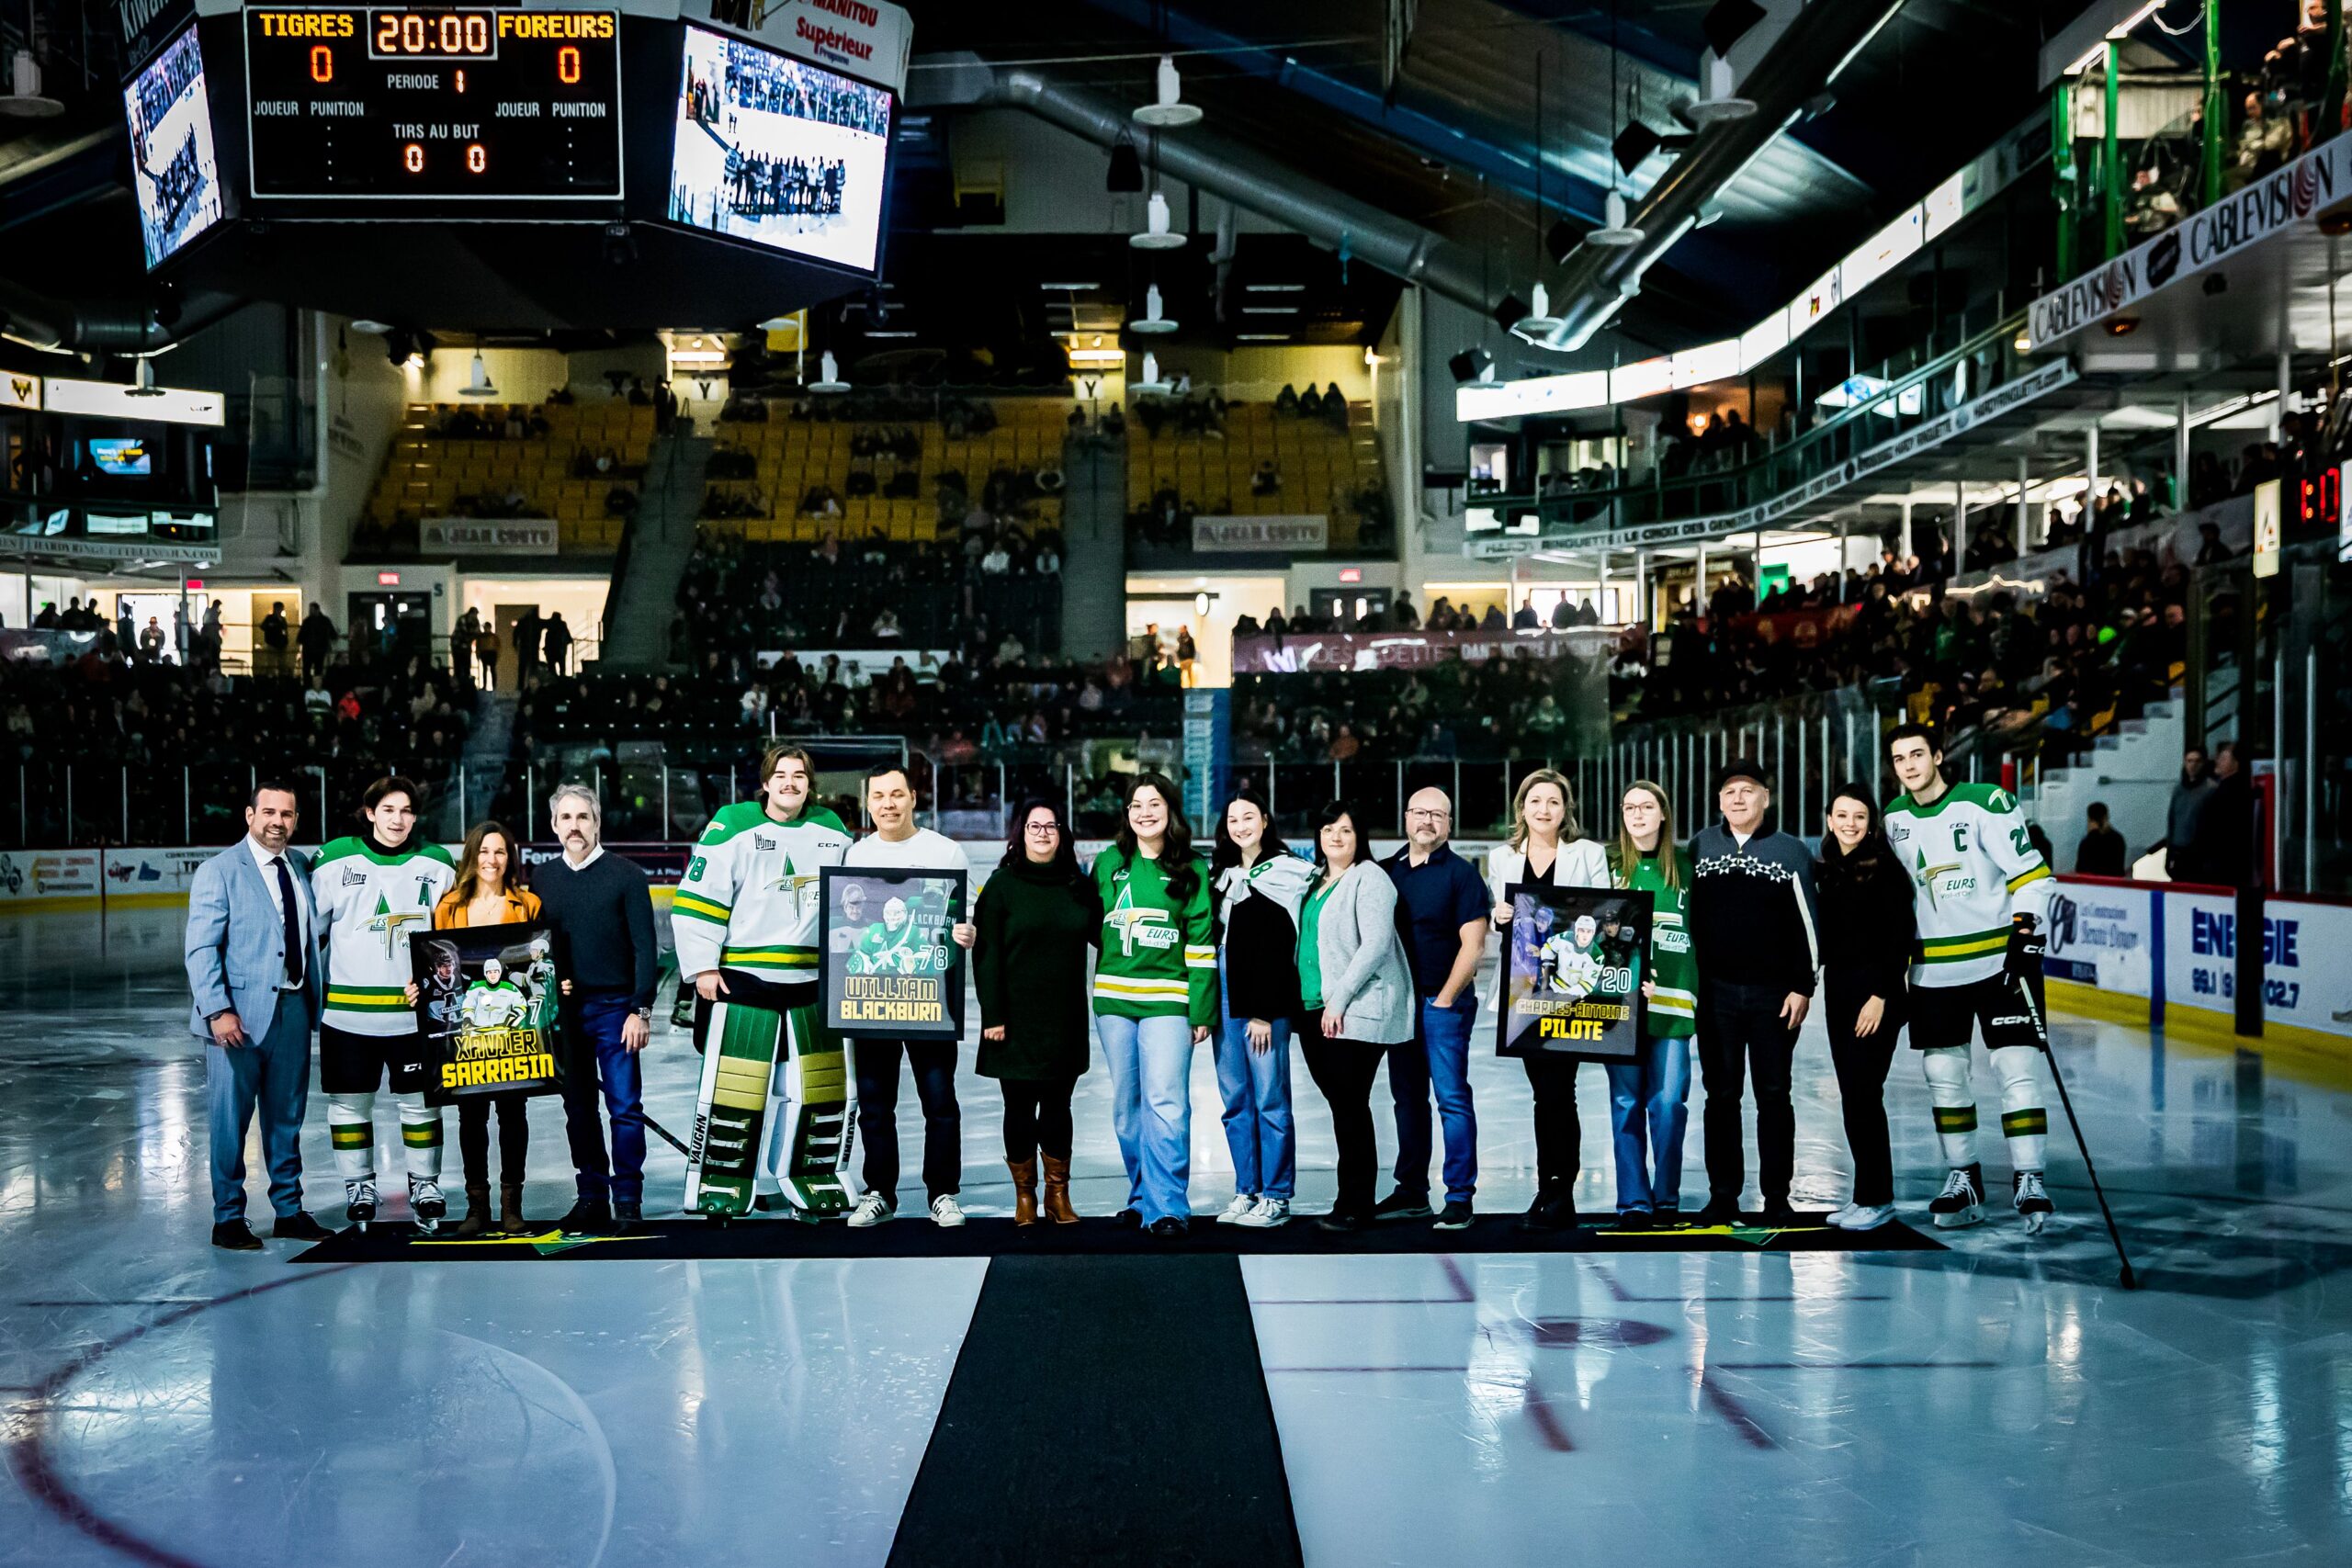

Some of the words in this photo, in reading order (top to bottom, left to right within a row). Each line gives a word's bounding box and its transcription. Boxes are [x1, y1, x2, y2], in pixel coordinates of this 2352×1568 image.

[259, 14, 354, 37] TIGRES
[379, 15, 487, 52] 20:00
[498, 15, 614, 38] FOREURS
[796, 17, 873, 61] Supérieur
[311, 46, 333, 83] 0
[558, 47, 581, 83] 0
[387, 73, 440, 90] PERIODE
[456, 70, 464, 93] 1
[254, 101, 300, 117] JOUEUR
[311, 101, 365, 117] PUNITION
[495, 102, 540, 118] JOUEUR
[552, 102, 606, 118] PUNITION
[393, 124, 424, 139] TIRS
[429, 124, 448, 139] AU
[453, 124, 480, 139] BUT
[406, 144, 423, 173] 0
[468, 145, 485, 173] 0
[2190, 148, 2334, 265] CABLEVISION
[2034, 254, 2137, 344] CABLEVISION
[698, 381, 711, 400] Y
[1085, 380, 1097, 398] Y
[433, 582, 443, 597] S
[1953, 828, 1968, 852] C
[183, 860, 207, 873] TR
[415, 875, 437, 885] CCM
[418, 883, 430, 907] A
[919, 944, 949, 971] 78
[844, 976, 939, 1001] WILLIAM
[1601, 966, 1633, 994] 20
[2263, 978, 2301, 1010] 02.7
[528, 998, 543, 1025] 7
[840, 1000, 943, 1022] BLACKBURN
[1516, 998, 1631, 1021] CHARLES-ANTOINE
[1991, 1015, 2031, 1027] CCM
[1539, 1017, 1604, 1041] PILOTE
[455, 1028, 537, 1062] XAVIER
[441, 1053, 555, 1089] SARRASIN
[689, 1113, 707, 1166] VAUGHN
